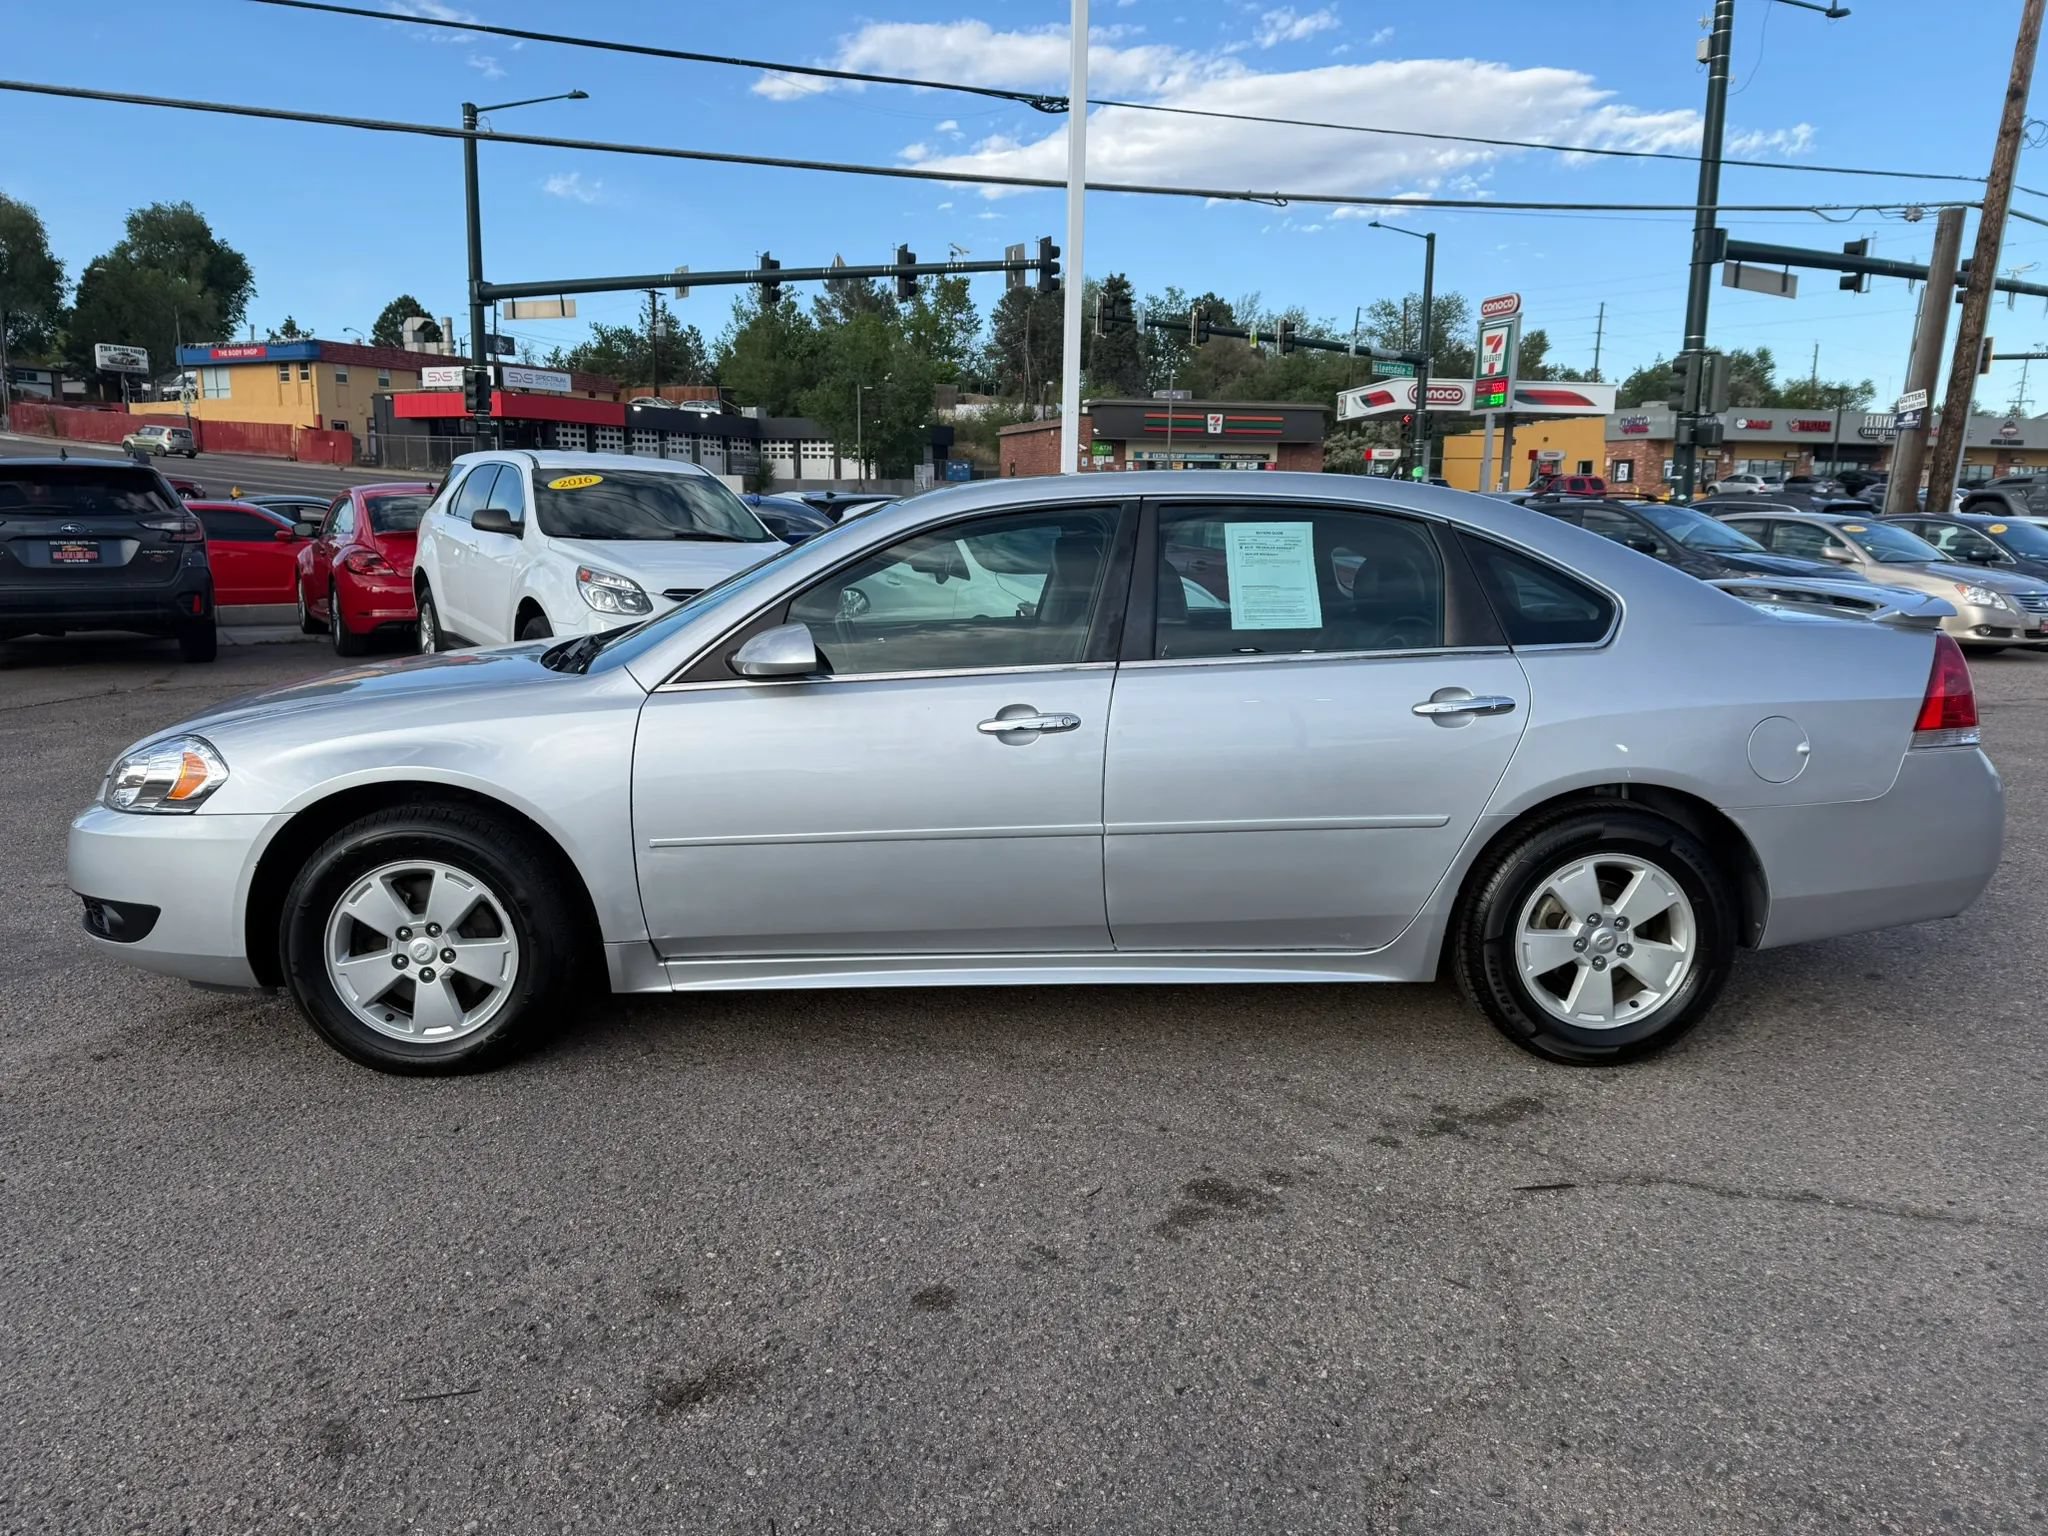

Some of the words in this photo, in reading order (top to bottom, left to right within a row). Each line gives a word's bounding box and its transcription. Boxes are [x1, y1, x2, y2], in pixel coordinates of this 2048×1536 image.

[130, 348, 146, 356] SHOP
[535, 374, 567, 384] SPECTRUM
[1899, 391, 1926, 404] GUTTERS
[1864, 415, 1897, 429] FLOYD'
[1863, 428, 1897, 436] BARBERSHO
[559, 476, 593, 488] 2016
